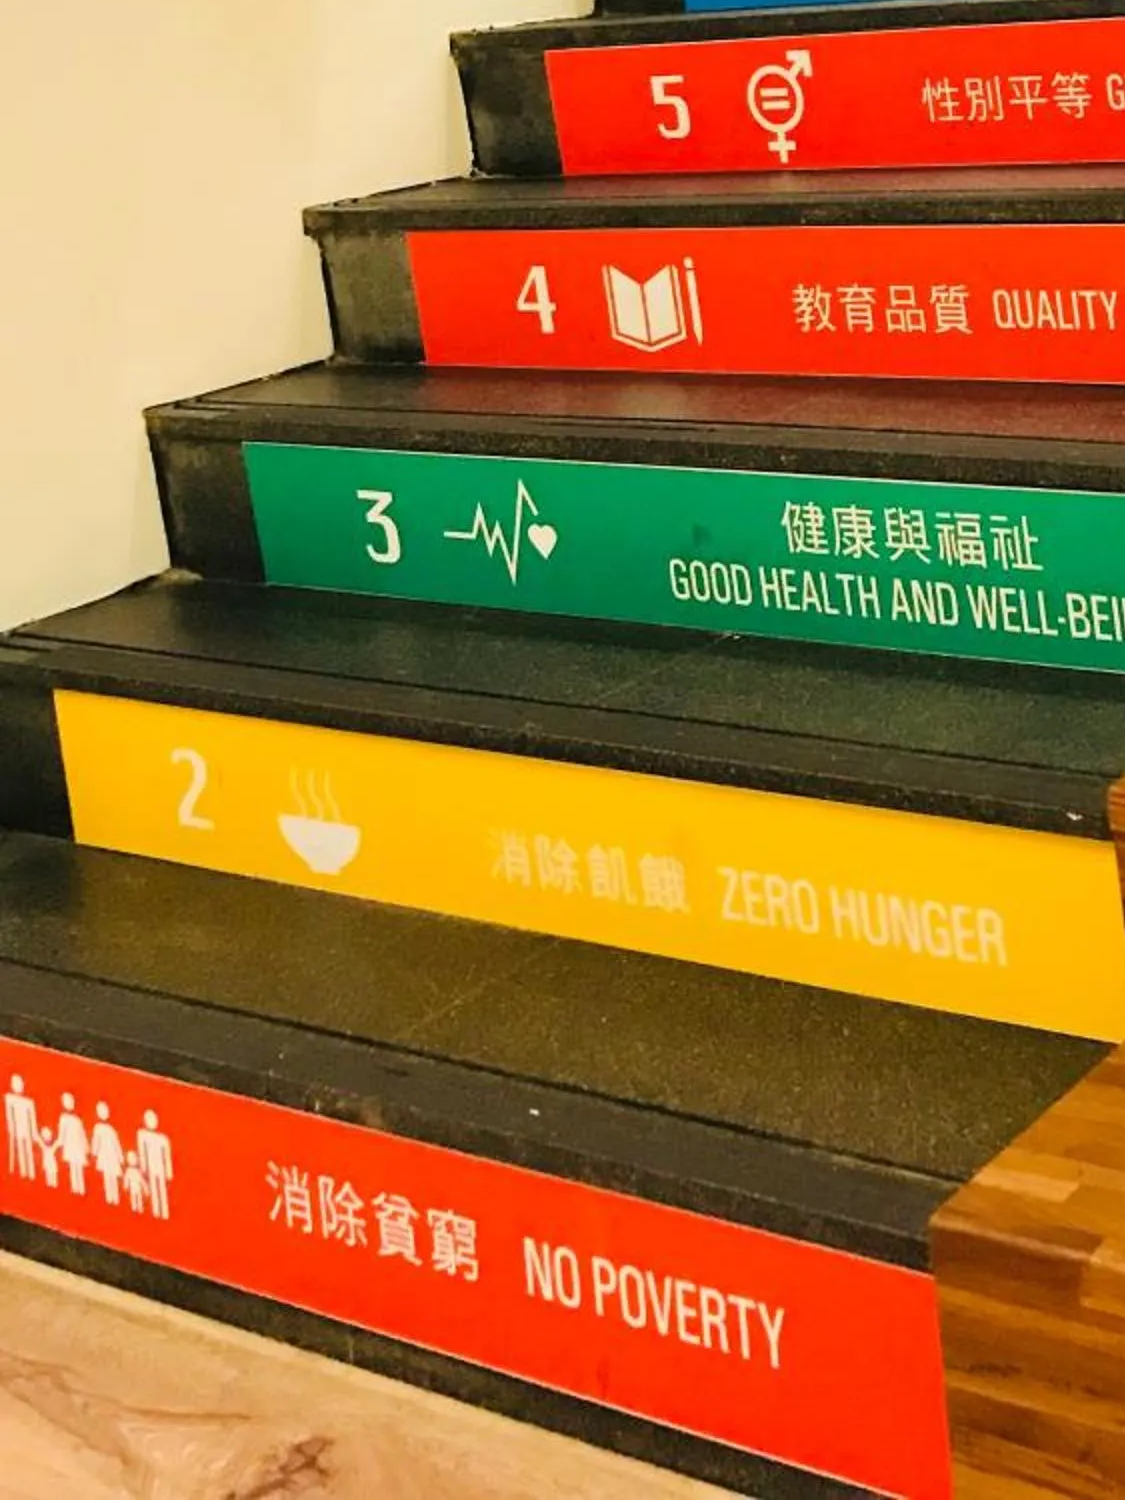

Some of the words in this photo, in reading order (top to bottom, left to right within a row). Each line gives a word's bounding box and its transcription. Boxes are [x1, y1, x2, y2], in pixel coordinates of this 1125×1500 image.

[650, 75, 691, 139] 5
[921, 71, 1093, 123] 性別平等
[517, 265, 557, 334] 4
[792, 284, 973, 335] 教育品質
[994, 289, 1117, 330] QUALITY
[356, 489, 401, 565] 3
[781, 501, 1043, 572] 健康與福祉
[669, 558, 753, 608] GOOD
[759, 565, 881, 620] HEALTH
[891, 578, 959, 628] AND
[170, 749, 215, 830] 2
[717, 866, 820, 936] ZERO
[829, 886, 1009, 967] HUNGER
[266, 1160, 479, 1282] 消除貧窮
[522, 1236, 581, 1308] NO
[592, 1255, 785, 1370] POVERTY
